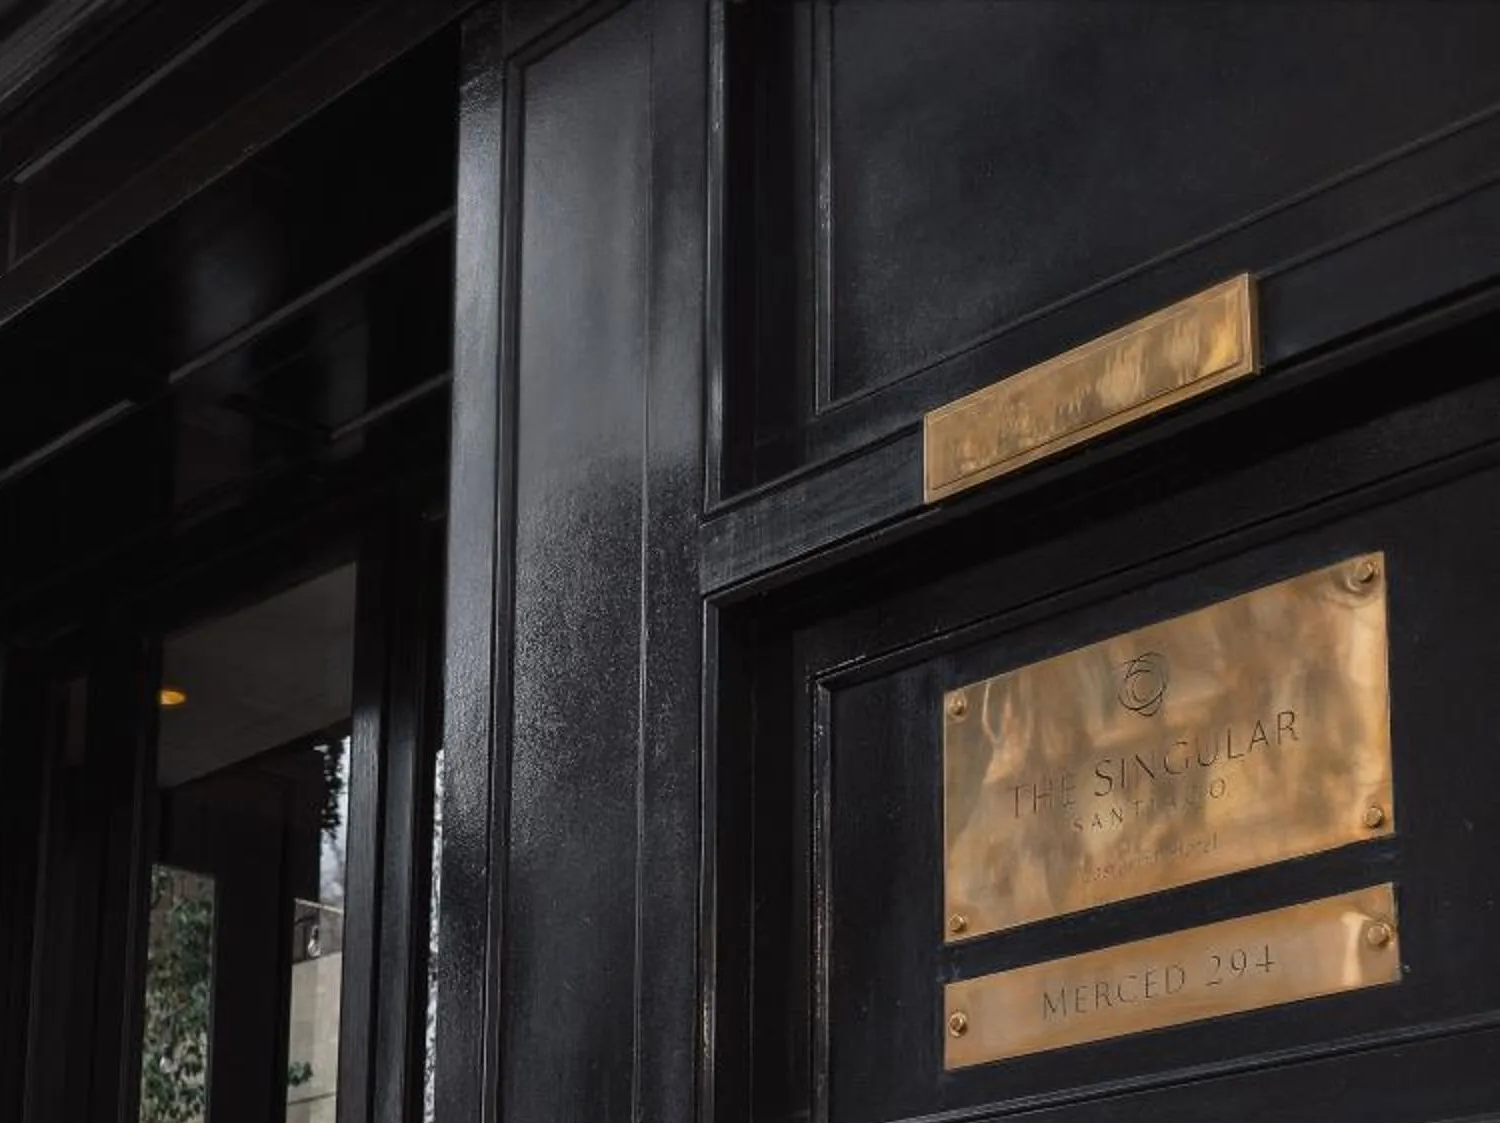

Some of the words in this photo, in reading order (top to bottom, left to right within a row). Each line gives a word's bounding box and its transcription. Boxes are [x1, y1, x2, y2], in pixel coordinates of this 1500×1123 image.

[1007, 772, 1077, 819] THE
[1093, 710, 1299, 797] SINGULAR
[1072, 777, 1226, 832] SANTIO
[1042, 963, 1186, 1020] MERCED
[1204, 943, 1275, 986] 294
